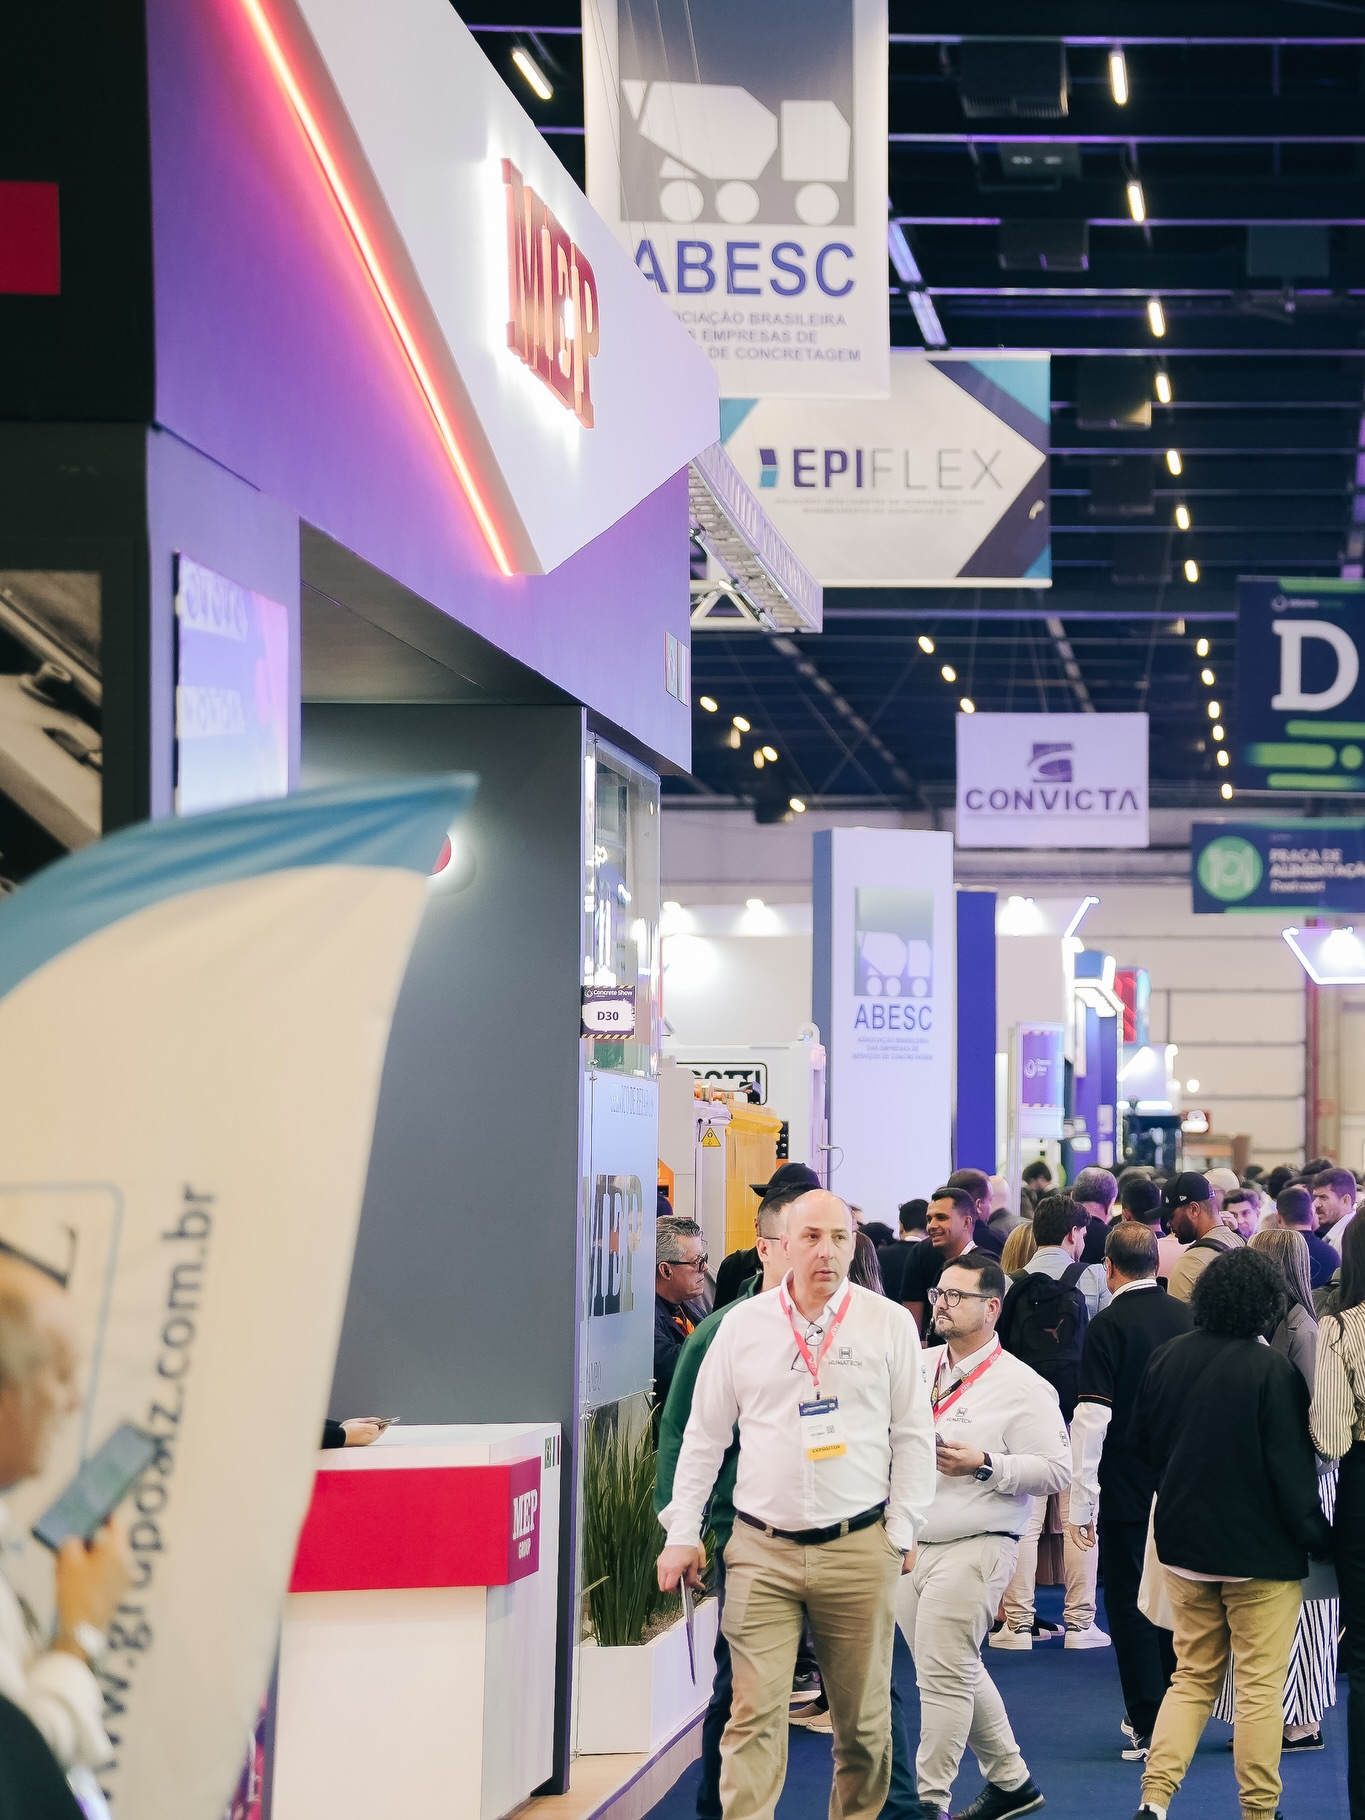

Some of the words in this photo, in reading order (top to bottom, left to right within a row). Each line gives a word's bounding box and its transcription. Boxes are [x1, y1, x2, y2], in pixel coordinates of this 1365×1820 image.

[635, 239, 855, 297] ABESC
[501, 158, 600, 429] MEP
[672, 310, 745, 327] CIAÇÃO
[750, 312, 847, 326] BRASILEIRA
[703, 330, 792, 343] EMPRESAS
[797, 332, 817, 343] DE
[709, 347, 730, 360] DE
[736, 347, 861, 361] CONCRETAGEM
[793, 447, 1003, 490] EPIFLEX
[1271, 620, 1360, 711] D
[965, 789, 1138, 810] CONVICTA
[597, 1011, 619, 1021] D30
[854, 1004, 933, 1031] ABESC
[512, 1489, 538, 1540] MEP
